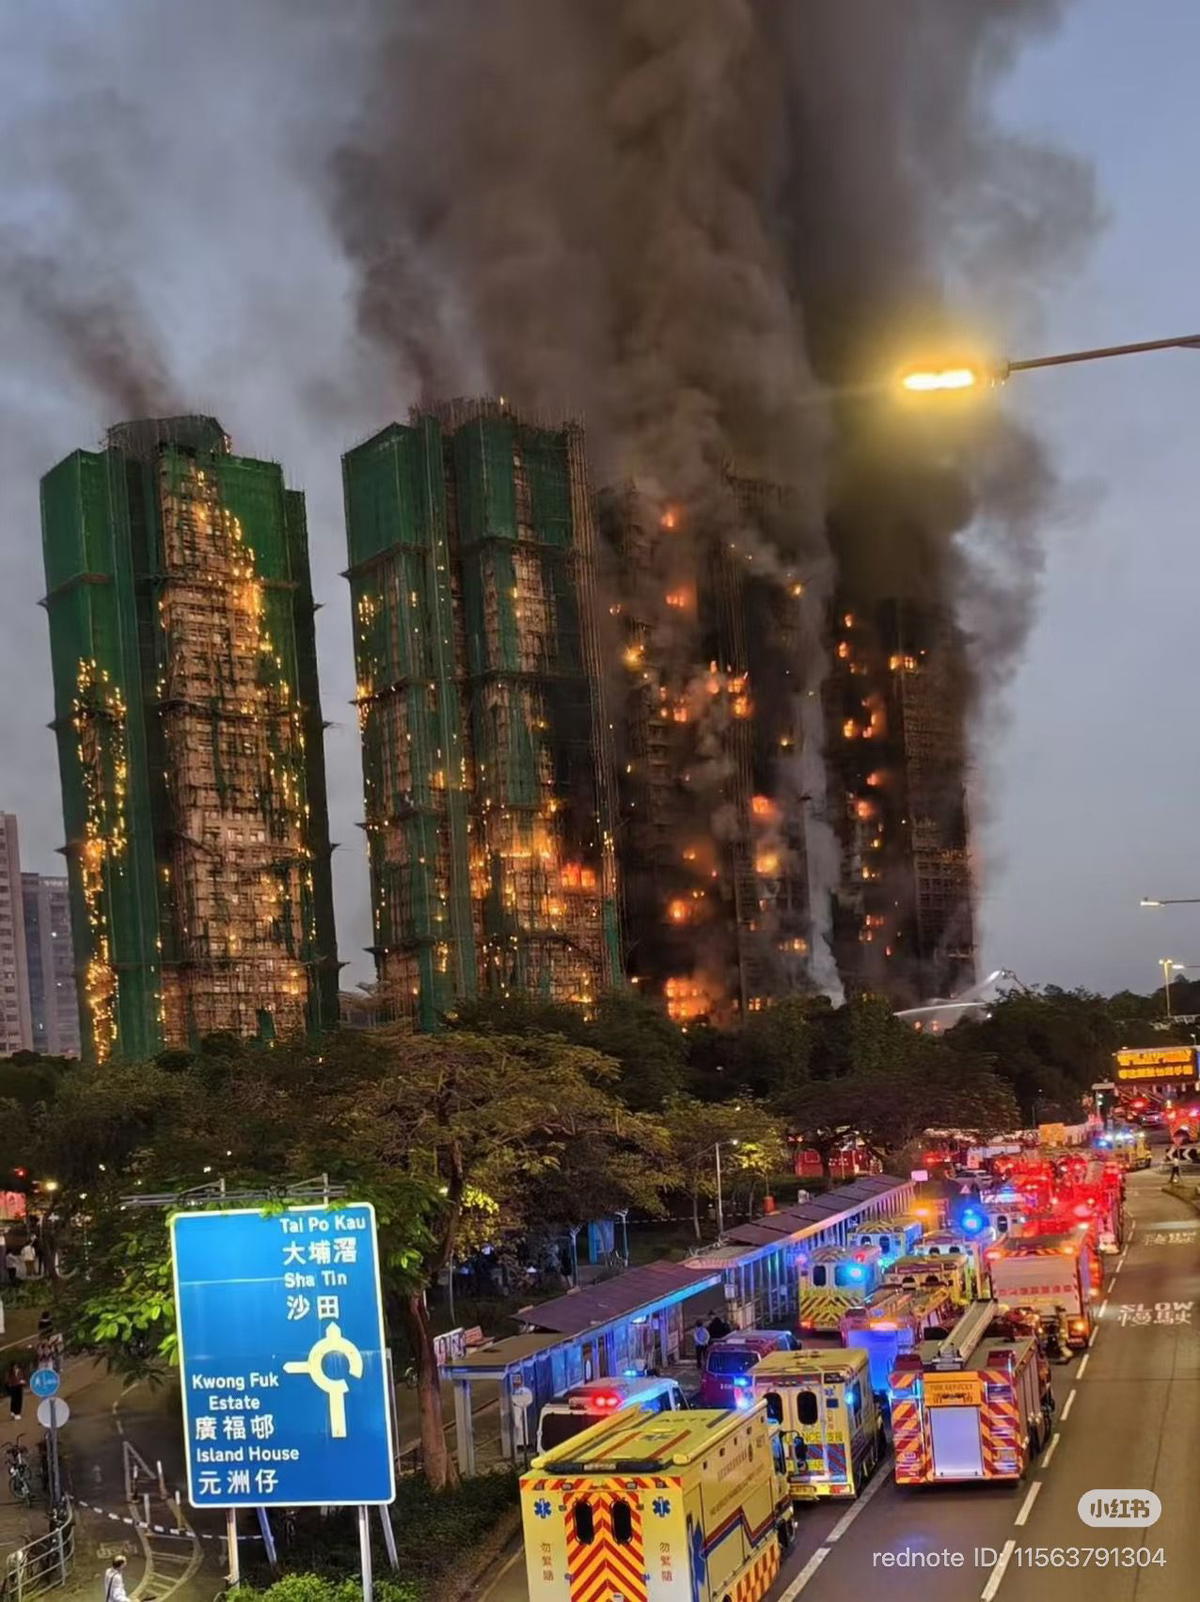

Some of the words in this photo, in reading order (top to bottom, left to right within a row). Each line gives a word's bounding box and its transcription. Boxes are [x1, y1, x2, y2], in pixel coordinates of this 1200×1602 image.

[280, 1217, 304, 1234] Tai
[308, 1216, 330, 1233] Po
[334, 1214, 366, 1231] Kau
[282, 1237, 357, 1266] 大埔滘
[284, 1272, 316, 1289] Sha
[321, 1269, 348, 1287] Tin
[286, 1294, 339, 1321] 沙田
[1119, 1302, 1194, 1313] SLOW
[192, 1374, 245, 1391] Kwong
[249, 1371, 279, 1388] Fuk
[208, 1395, 261, 1411] Estate
[195, 1413, 275, 1441] 廣福邨
[196, 1446, 244, 1463] Island
[248, 1446, 300, 1461] House
[198, 1468, 279, 1495] 元洲仔
